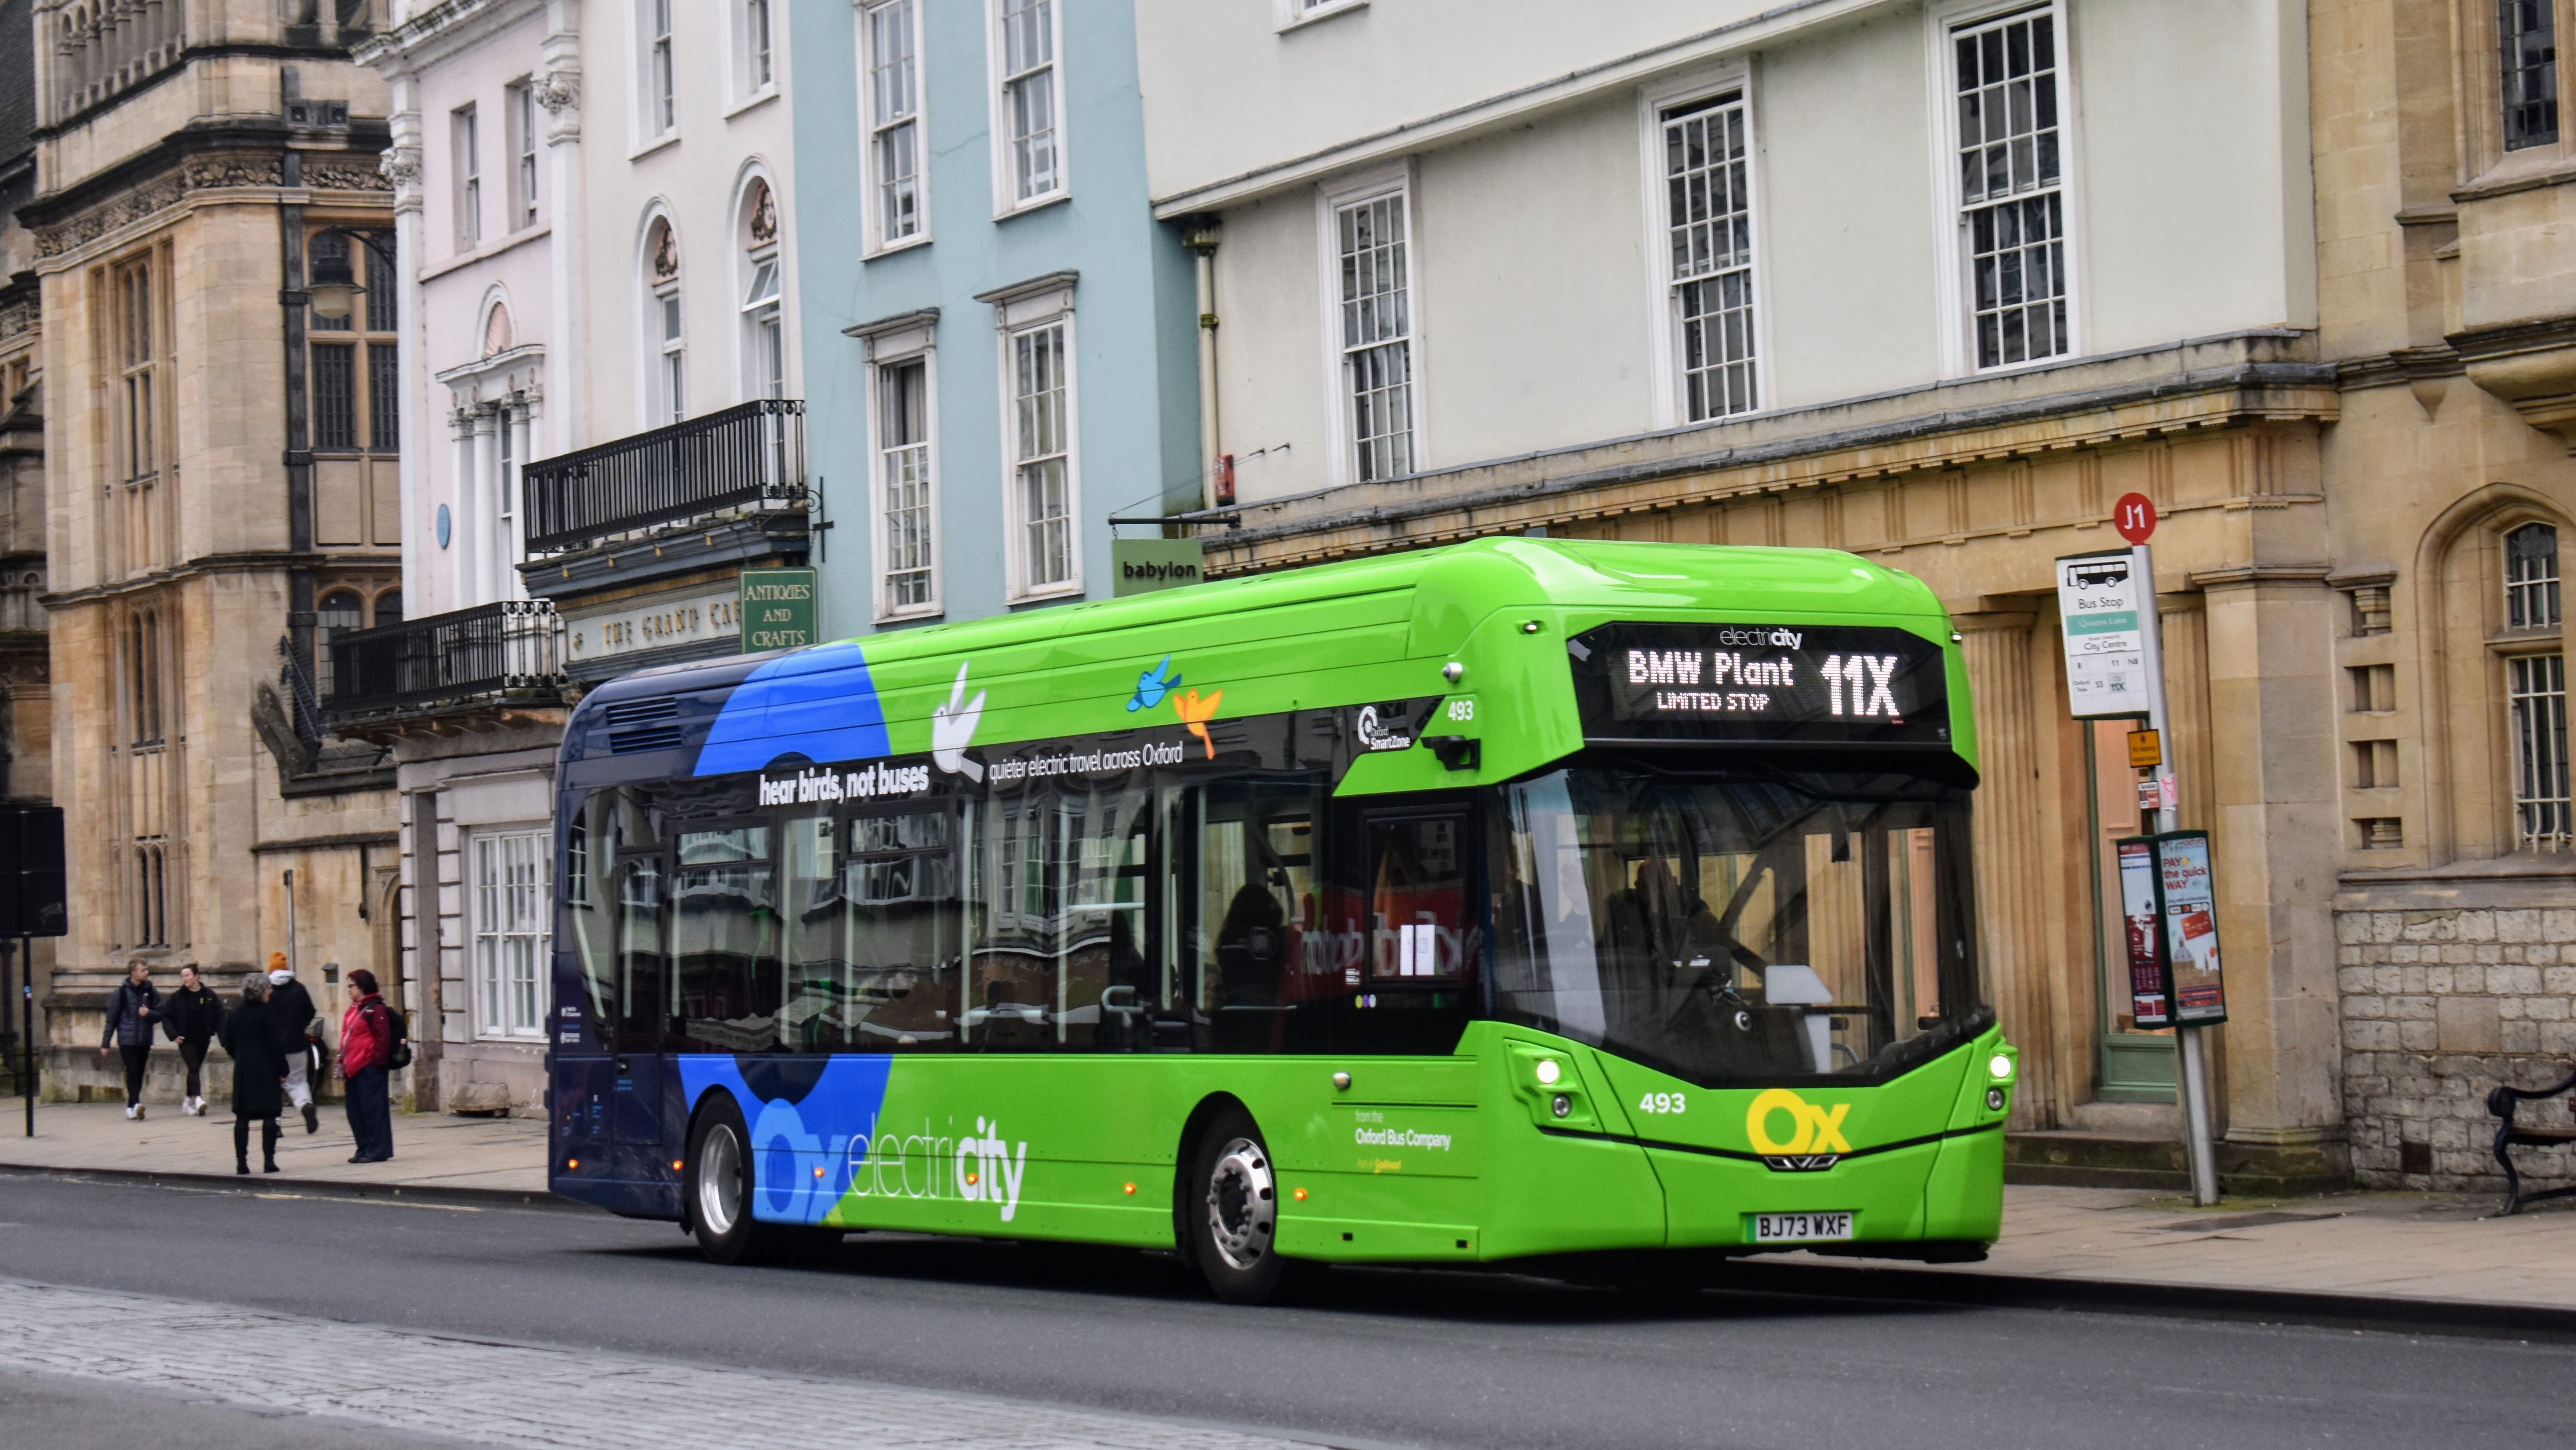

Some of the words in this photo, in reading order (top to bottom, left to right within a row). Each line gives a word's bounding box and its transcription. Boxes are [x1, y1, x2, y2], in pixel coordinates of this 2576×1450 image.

[2124, 504, 2145, 529] J1
[1123, 561, 1196, 580] babylon
[745, 585, 811, 600] ANTIQUES
[2078, 599, 2097, 609] Bus
[2100, 597, 2123, 609] Stop
[762, 609, 792, 621] AND
[603, 620, 632, 645] THE
[642, 607, 700, 640] GRAND
[752, 630, 806, 647] CRAFTS
[1719, 627, 1802, 650] electricity
[2084, 643, 2100, 651] City
[1629, 651, 1702, 684] BMW
[1715, 652, 1794, 685] Plant
[1820, 654, 1900, 715] 11X
[1448, 701, 1473, 720] 493
[1657, 692, 1721, 710] LIMITED
[1727, 693, 1770, 710] STOP
[1371, 726, 1389, 736] Oxford
[1370, 736, 1410, 750] SmartZone
[989, 759, 1027, 784] quieter
[1028, 754, 1068, 776] electric
[1069, 749, 1101, 772] travel
[1103, 750, 1141, 769] across
[1142, 741, 1183, 766] Oxford
[759, 774, 797, 806] hear
[799, 767, 844, 804] birds,
[846, 766, 876, 797] not
[878, 762, 929, 794] buses
[2163, 857, 2181, 867] PAY
[2164, 870, 2179, 879] the
[2181, 866, 2207, 879] quick
[2165, 880, 2188, 890] WAY
[1640, 1093, 1686, 1113] 493
[1355, 1109, 1372, 1122] from
[1373, 1110, 1384, 1123] the
[1746, 1088, 1853, 1155] Ox
[1355, 1128, 1386, 1145] Oxford
[1387, 1128, 1405, 1145] Bus
[1406, 1129, 1452, 1152] Company
[848, 1112, 1027, 1222] electricity
[1759, 1216, 1807, 1237] BJ73
[1814, 1215, 1848, 1235] WXF
